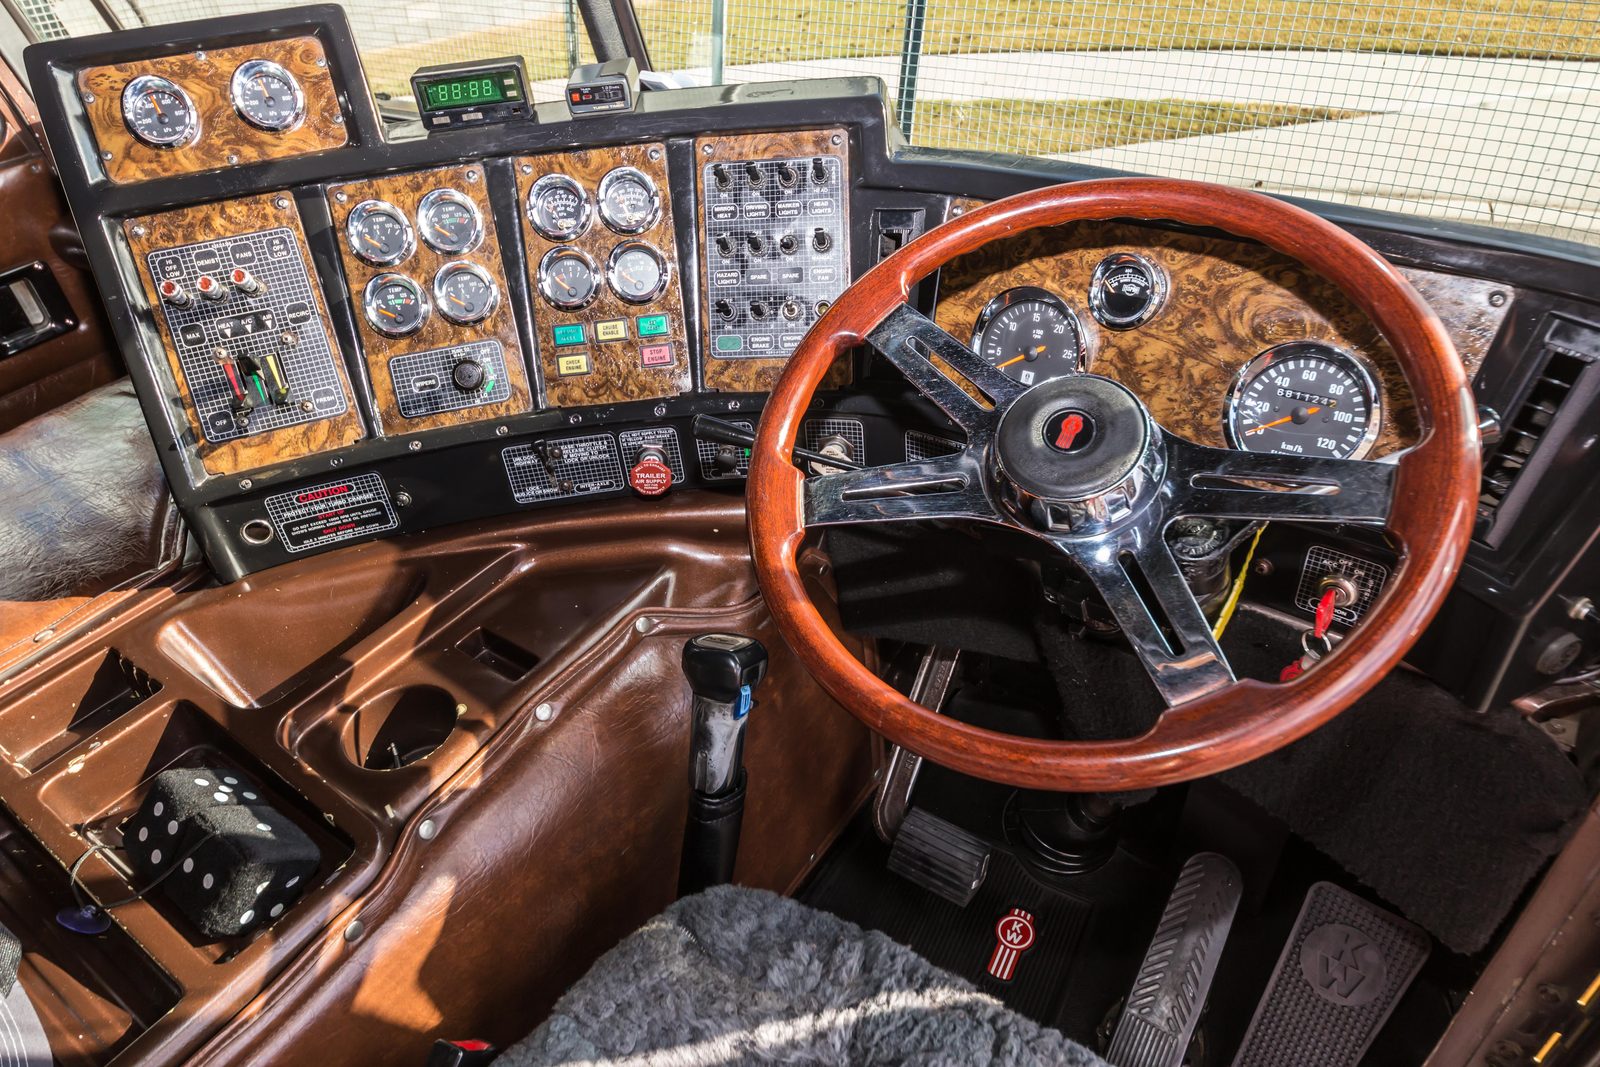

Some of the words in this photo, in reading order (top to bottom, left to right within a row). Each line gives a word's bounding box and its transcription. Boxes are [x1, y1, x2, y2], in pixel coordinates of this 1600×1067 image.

[438, 80, 492, 101] 88:88
[236, 251, 252, 259] FANS
[273, 250, 288, 258] LOW
[197, 258, 220, 267] DEMIST
[716, 271, 738, 279] HAZARD
[262, 313, 273, 321] AIR
[288, 308, 310, 318] RECIRC
[1032, 312, 1041, 322] 15
[240, 316, 252, 324] A/C
[217, 321, 234, 330] HEAT
[1008, 321, 1018, 332] 10
[1053, 324, 1065, 335] 20
[186, 331, 201, 340] MAX
[649, 348, 663, 356] STOP
[995, 347, 1002, 356] 5
[1062, 349, 1074, 360] 25
[647, 354, 667, 363] ENGINE
[1301, 369, 1318, 381] 60
[415, 379, 437, 388] WIPERS
[1274, 375, 1291, 388] 40
[1328, 383, 1345, 396] 80
[316, 394, 335, 404] FRESH
[1255, 401, 1271, 413] 20
[1333, 410, 1354, 424] 100
[215, 419, 227, 427] OFF
[1280, 441, 1304, 454] km/h
[1316, 436, 1337, 450] 120
[580, 481, 610, 489] INTER-AXLE
[298, 485, 349, 503] CAUTION
[283, 509, 311, 518] PROTECT
[348, 493, 375, 502] CHARGER
[318, 512, 335, 520] START
[361, 511, 381, 519] PRESSURE
[322, 527, 337, 535] SHUT
[338, 523, 356, 531] DOWN
[318, 533, 336, 541] MINUTES
[1322, 560, 1338, 568] ACC
[1354, 569, 1365, 577] ON
[1012, 920, 1024, 934] K
[1007, 929, 1023, 944] W
